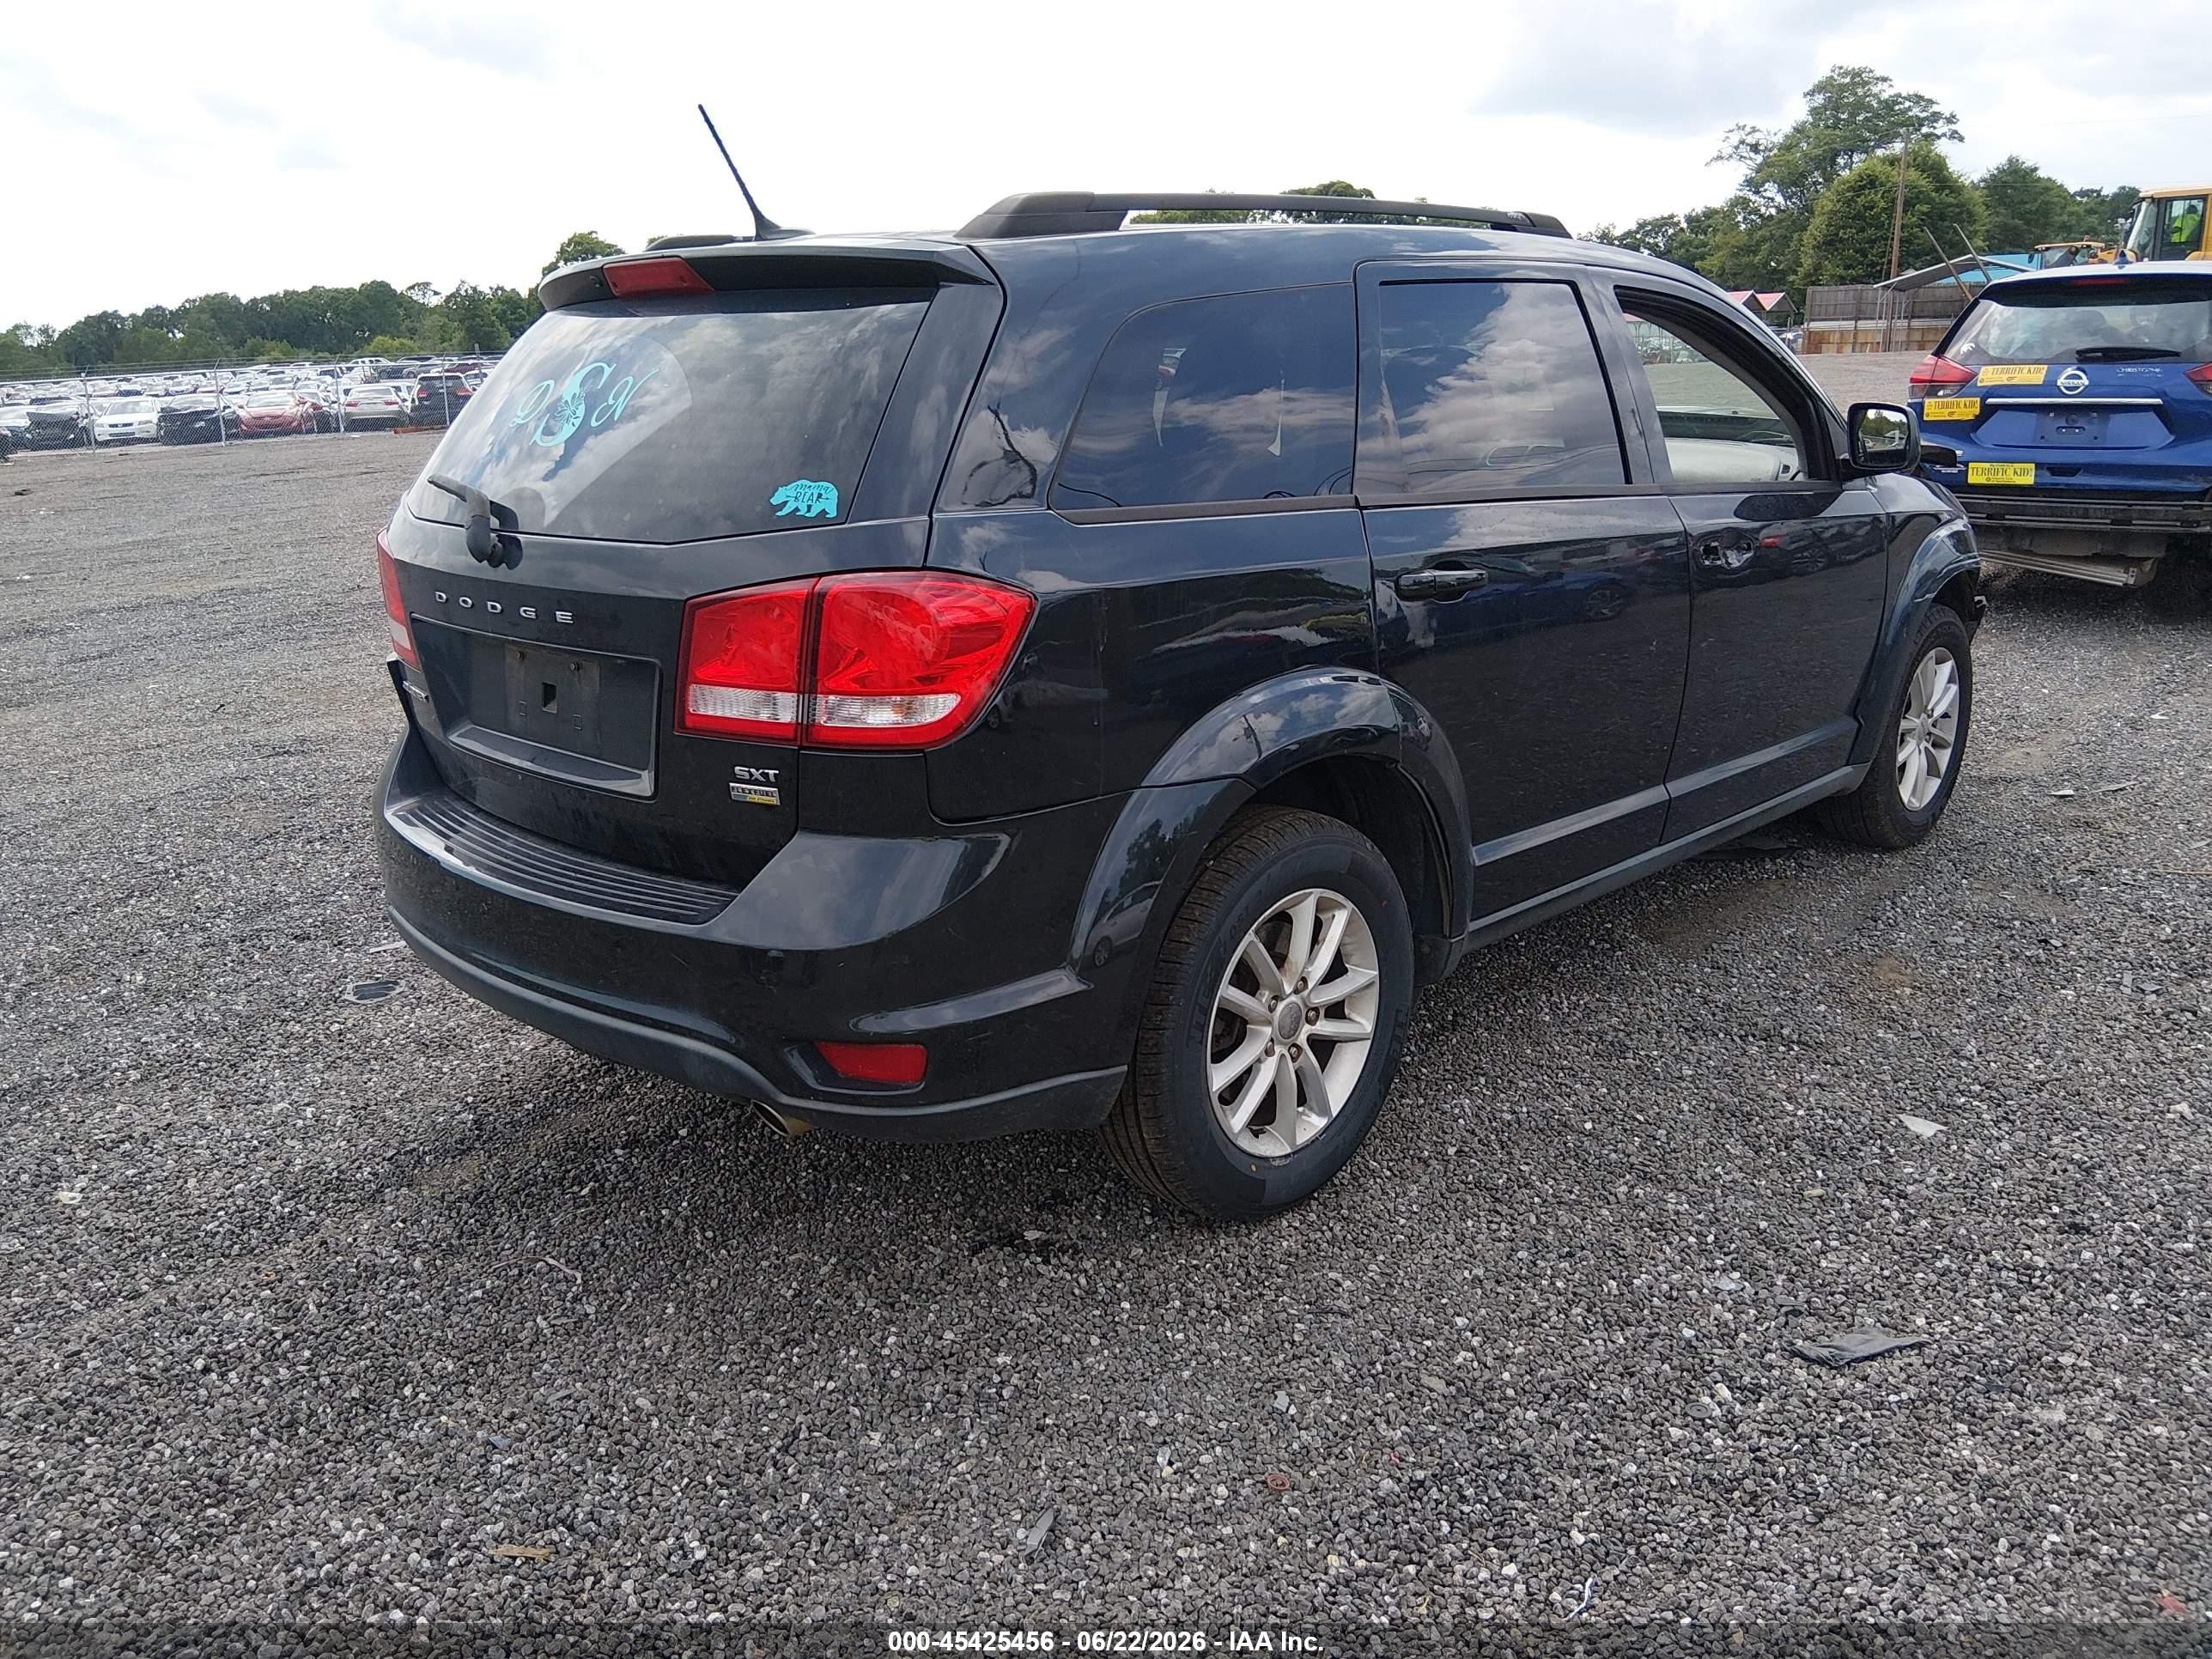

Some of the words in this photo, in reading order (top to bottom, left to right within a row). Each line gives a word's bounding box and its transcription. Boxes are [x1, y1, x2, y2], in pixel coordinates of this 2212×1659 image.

[1970, 466, 2011, 477] TERRIFIC
[2013, 467, 2033, 477] KID!
[794, 491, 823, 504] BEAR
[434, 591, 574, 623] DODGE
[734, 766, 779, 782] SXT
